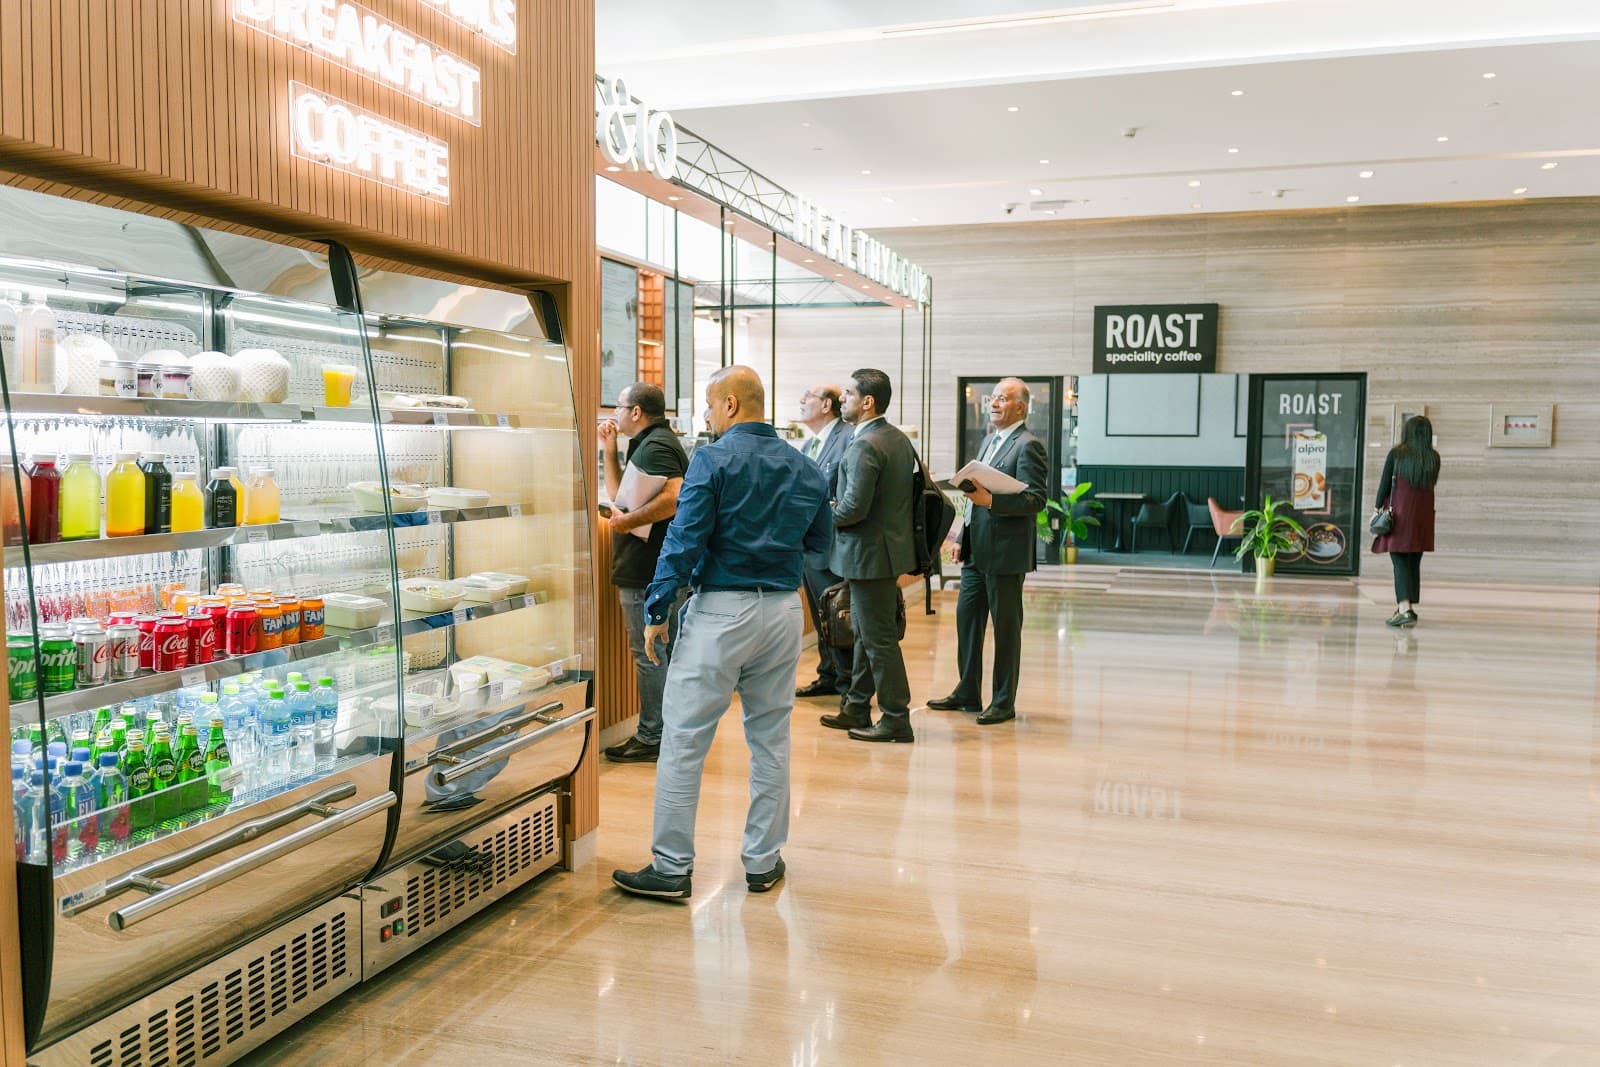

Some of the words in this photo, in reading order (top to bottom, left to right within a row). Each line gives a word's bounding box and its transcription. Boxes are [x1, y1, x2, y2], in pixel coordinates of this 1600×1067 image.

[296, 92, 449, 198] COFFEE
[1105, 313, 1204, 348] ROAST
[1105, 350, 1163, 364] speciality
[1164, 350, 1202, 362] coffee
[1279, 393, 1342, 415] ROAST
[1297, 441, 1326, 456] alpro
[304, 607, 324, 622] FAN
[262, 616, 282, 631] FAN
